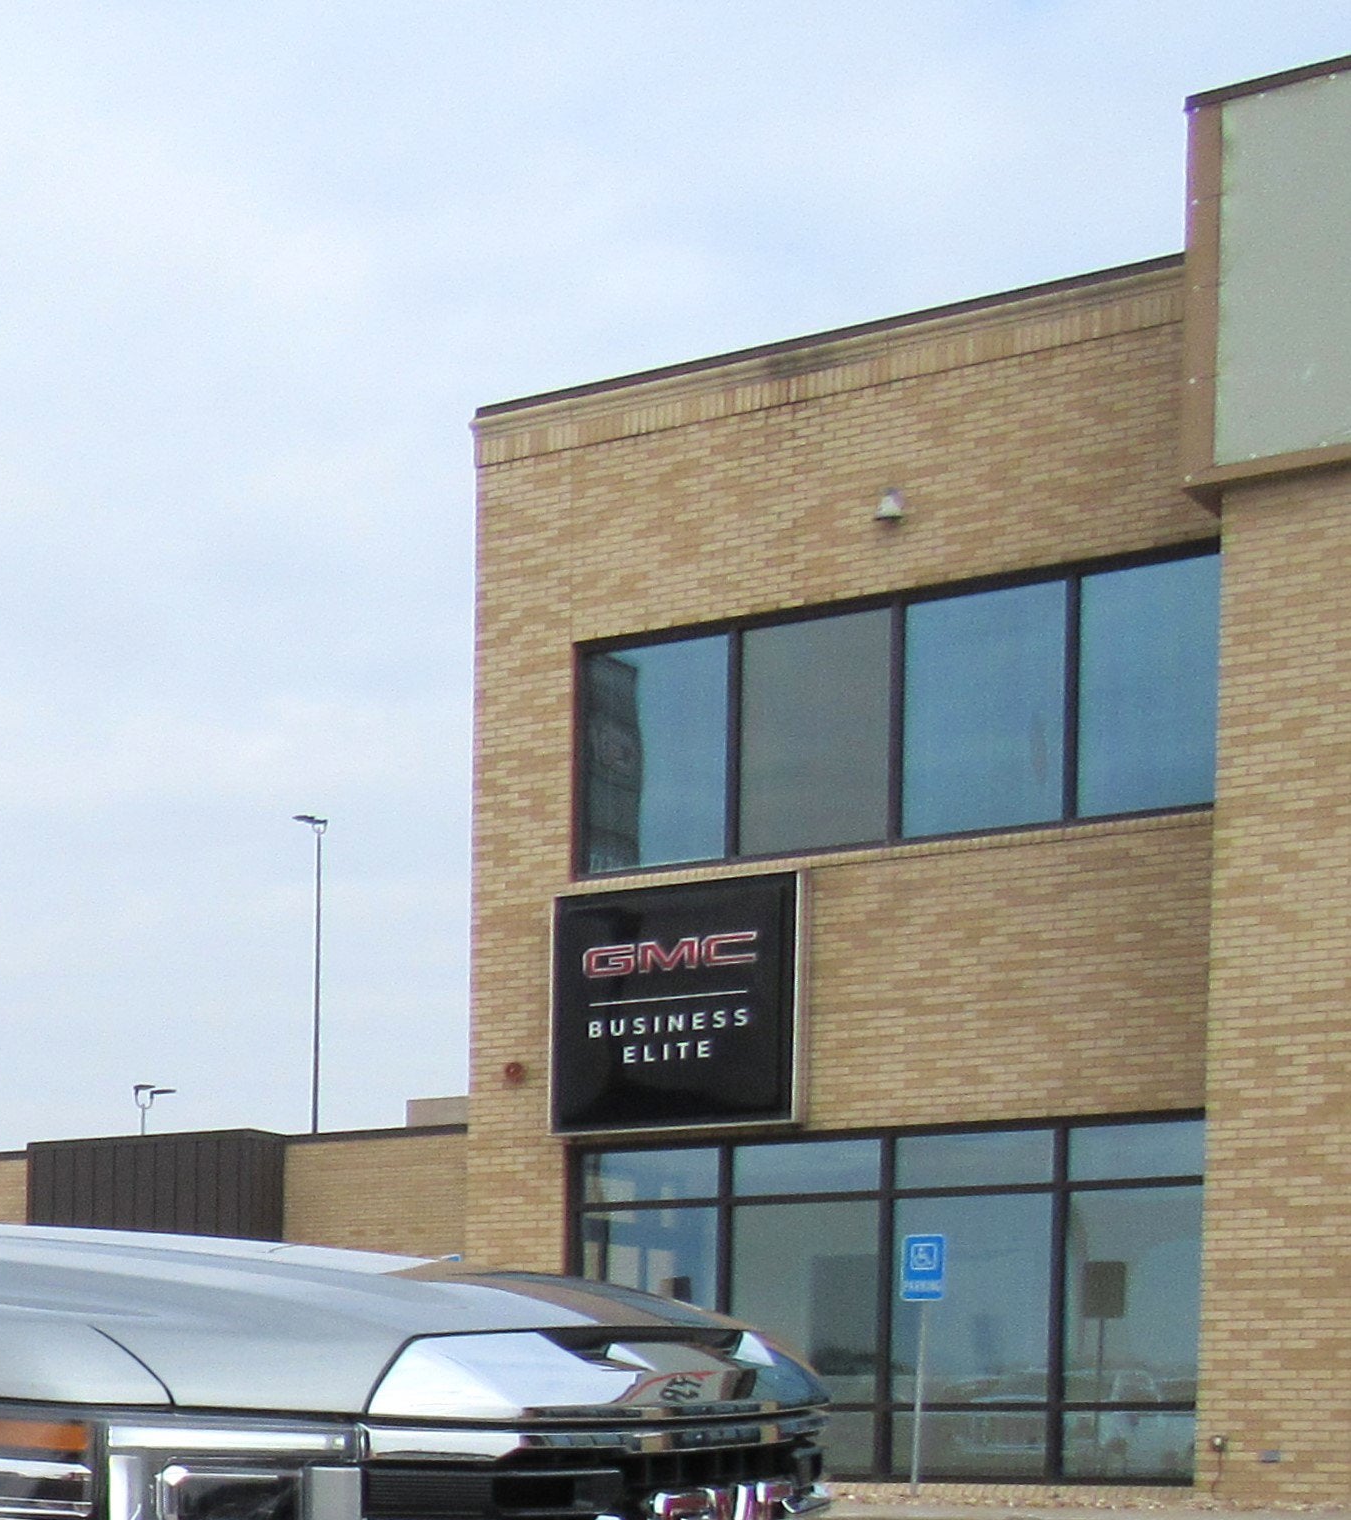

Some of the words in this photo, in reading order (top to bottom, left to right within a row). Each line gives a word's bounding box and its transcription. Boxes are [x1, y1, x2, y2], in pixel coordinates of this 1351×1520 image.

[582, 931, 758, 978] GMC
[587, 1008, 749, 1039] BUSINESS
[622, 1040, 712, 1064] ELITE
